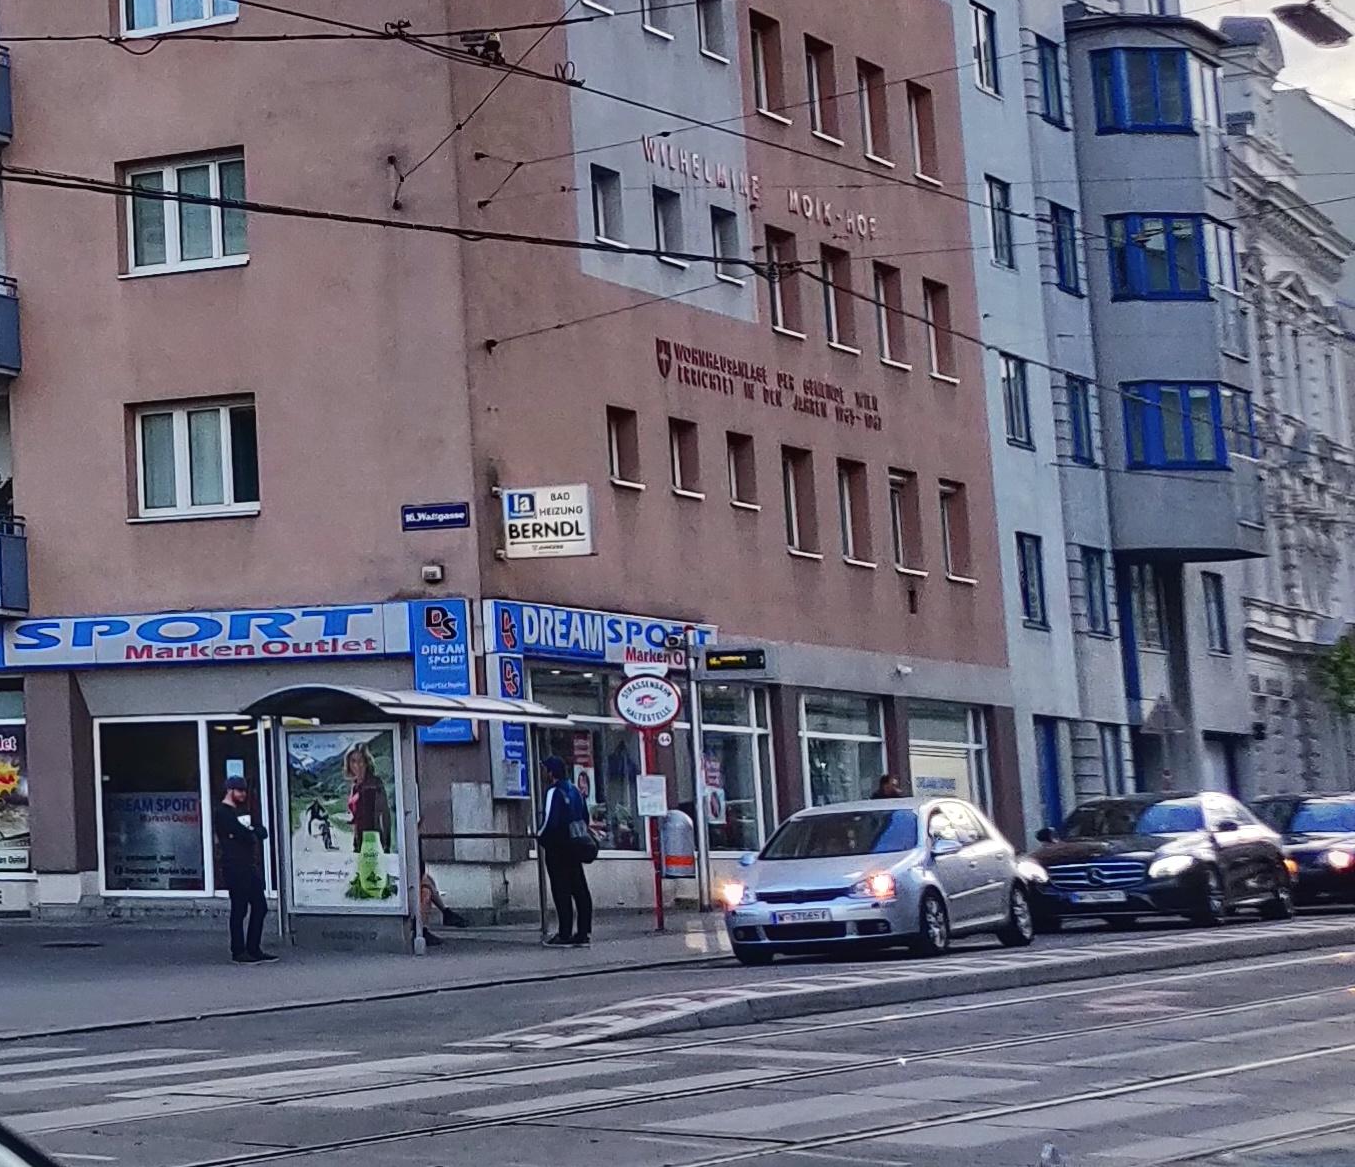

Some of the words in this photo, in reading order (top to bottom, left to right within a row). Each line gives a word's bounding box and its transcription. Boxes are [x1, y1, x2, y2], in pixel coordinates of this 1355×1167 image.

[641, 134, 760, 201] WILHELMINE
[550, 491, 570, 501] BAD
[539, 505, 584, 516] HEIZUNG
[508, 521, 586, 539] BERNDL
[14, 608, 374, 650] SPORT
[522, 606, 605, 653] DREAM
[607, 618, 712, 648] SPOT
[125, 643, 254, 660] Marken
[261, 637, 377, 655] Outlet
[421, 643, 466, 655] DREAM
[624, 645, 671, 664] Marken
[427, 654, 465, 665] SPORT
[621, 680, 672, 700] STRASSENBAHN
[625, 706, 671, 723] HALTESTELLE
[156, 797, 198, 812] SPORT
